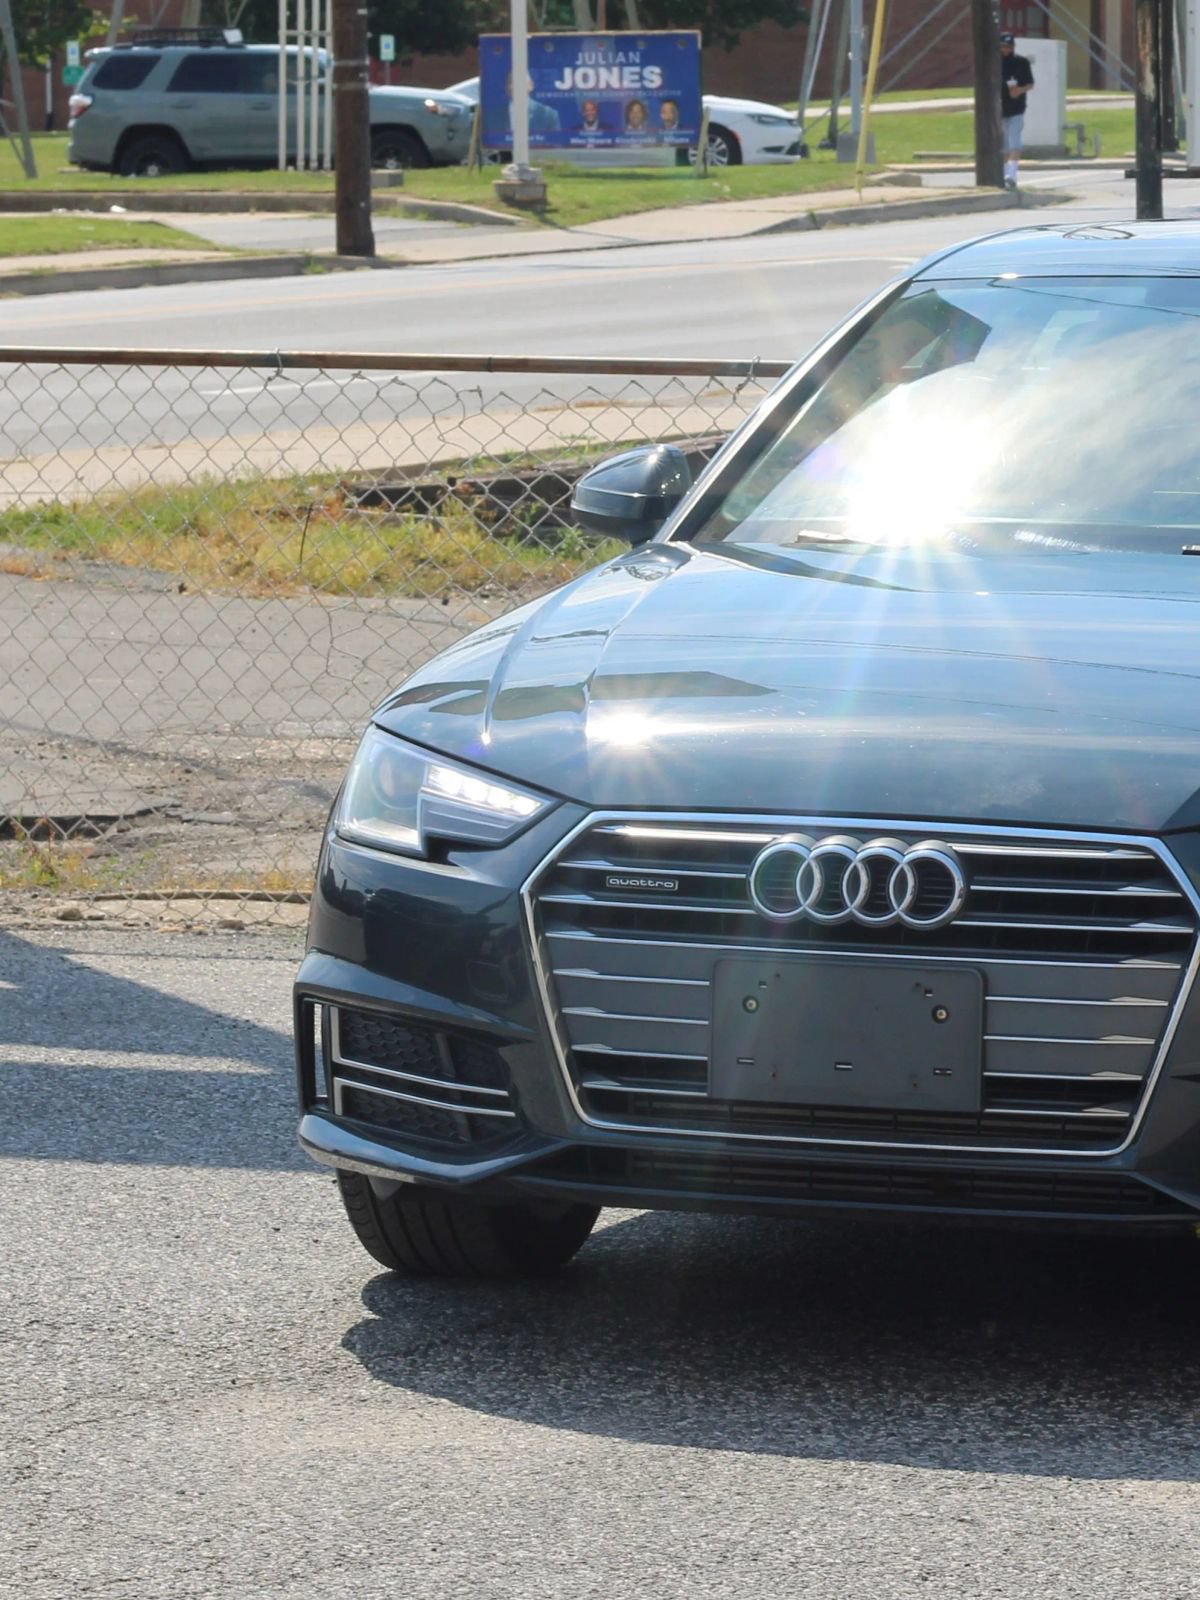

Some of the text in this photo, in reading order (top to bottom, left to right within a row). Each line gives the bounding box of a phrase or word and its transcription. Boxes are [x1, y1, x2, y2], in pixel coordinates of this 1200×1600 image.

[575, 51, 641, 65] JULIAN
[554, 65, 664, 90] JONES
[608, 877, 675, 889] quattro
